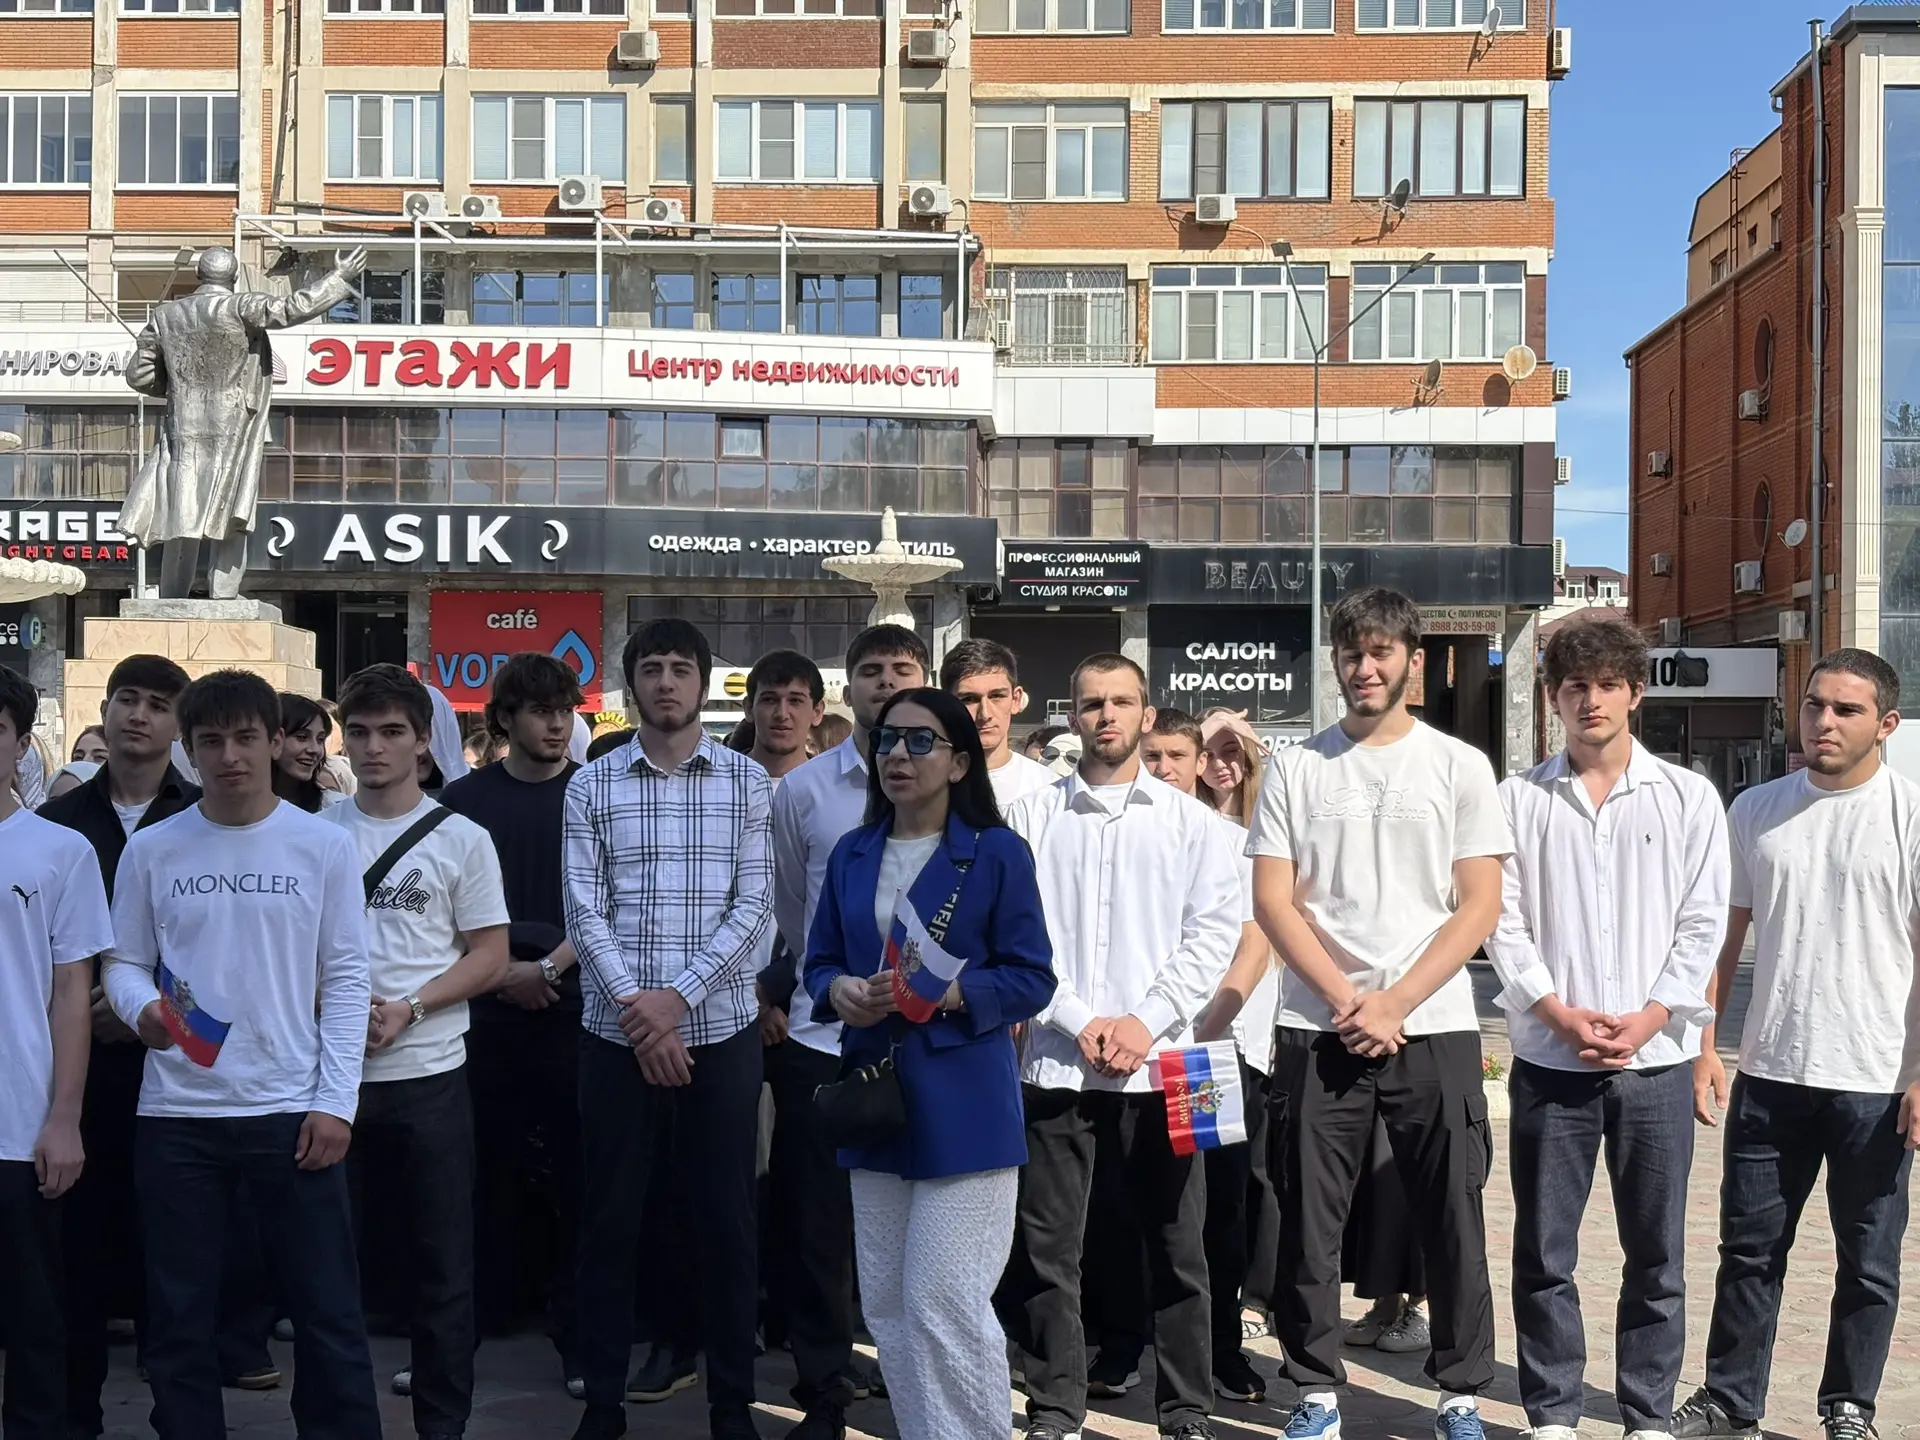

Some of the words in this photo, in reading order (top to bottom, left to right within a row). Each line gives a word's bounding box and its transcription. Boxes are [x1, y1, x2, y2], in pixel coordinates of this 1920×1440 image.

[628, 349, 722, 385] Центр
[733, 360, 960, 387] недвижимости
[323, 513, 513, 564] ASIK
[648, 533, 741, 554] одежда
[763, 536, 871, 559] характер
[901, 540, 956, 556] тиль
[62, 546, 129, 561] GEAR
[1008, 551, 1141, 563] ПРОФЕССИОНАЛЬНЫЙ
[1045, 567, 1104, 577] МАГАЗИН
[1020, 585, 1067, 596] СТУДИЯ
[1072, 585, 1128, 596] КРАСОТЫ
[486, 609, 538, 629] café
[1430, 621, 1451, 632] 8988
[1186, 642, 1276, 660] САЛОН
[1170, 673, 1292, 691] КРАСОТЫ
[171, 873, 302, 898] MONCLER
